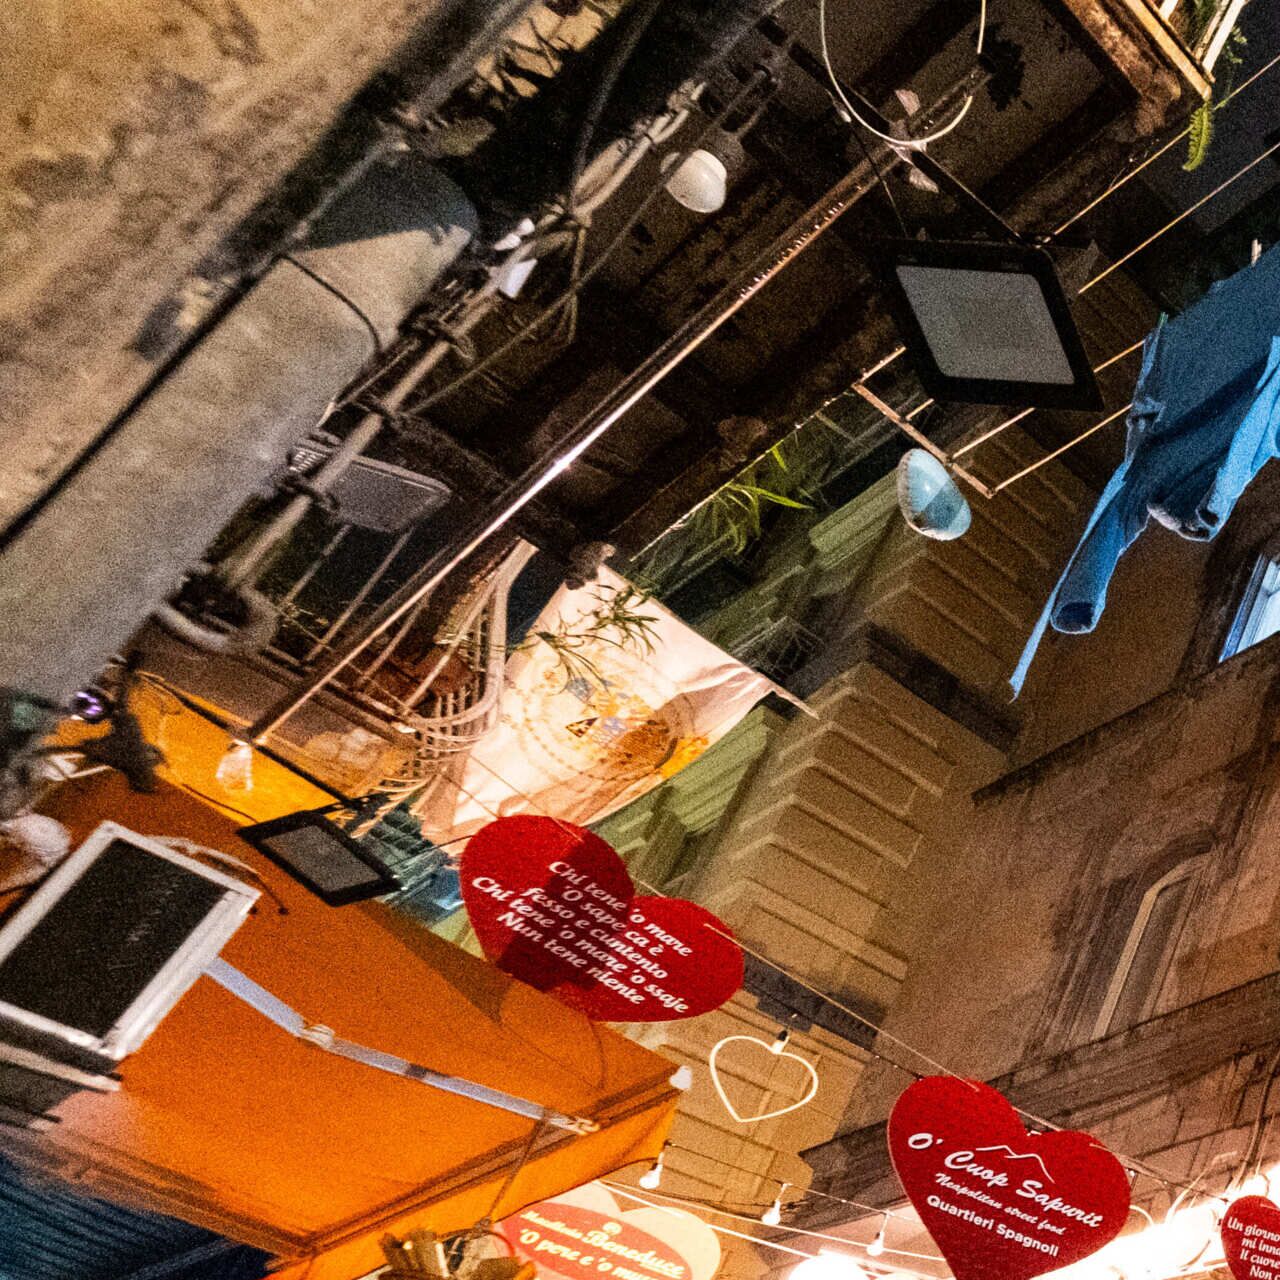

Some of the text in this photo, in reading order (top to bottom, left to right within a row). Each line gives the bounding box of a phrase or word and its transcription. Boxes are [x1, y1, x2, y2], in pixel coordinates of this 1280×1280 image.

[472, 876, 513, 901] Chi
[509, 897, 555, 928] tene
[575, 939, 628, 973] mare
[520, 887, 668, 979] fesso e cuntento
[549, 861, 585, 886] Chi
[584, 882, 627, 911] tene
[644, 920, 693, 957] mare
[581, 902, 627, 932] sape
[624, 925, 649, 948] ca
[497, 911, 646, 1005] Nun tene niente
[935, 1172, 1067, 1236] Neapolitan street food
[944, 1151, 1104, 1228] Cuop Sapurit
[534, 1240, 581, 1261] pere
[579, 1256, 595, 1266] e
[927, 1195, 1060, 1257] Quartieri Spagnoli
[1227, 1216, 1243, 1232] Un
[1244, 1225, 1280, 1243] giorno
[1241, 1237, 1257, 1250] mi
[581, 1230, 686, 1277] Beneduce
[1249, 1266, 1273, 1280] Non
[1250, 1254, 1280, 1269] cuore
